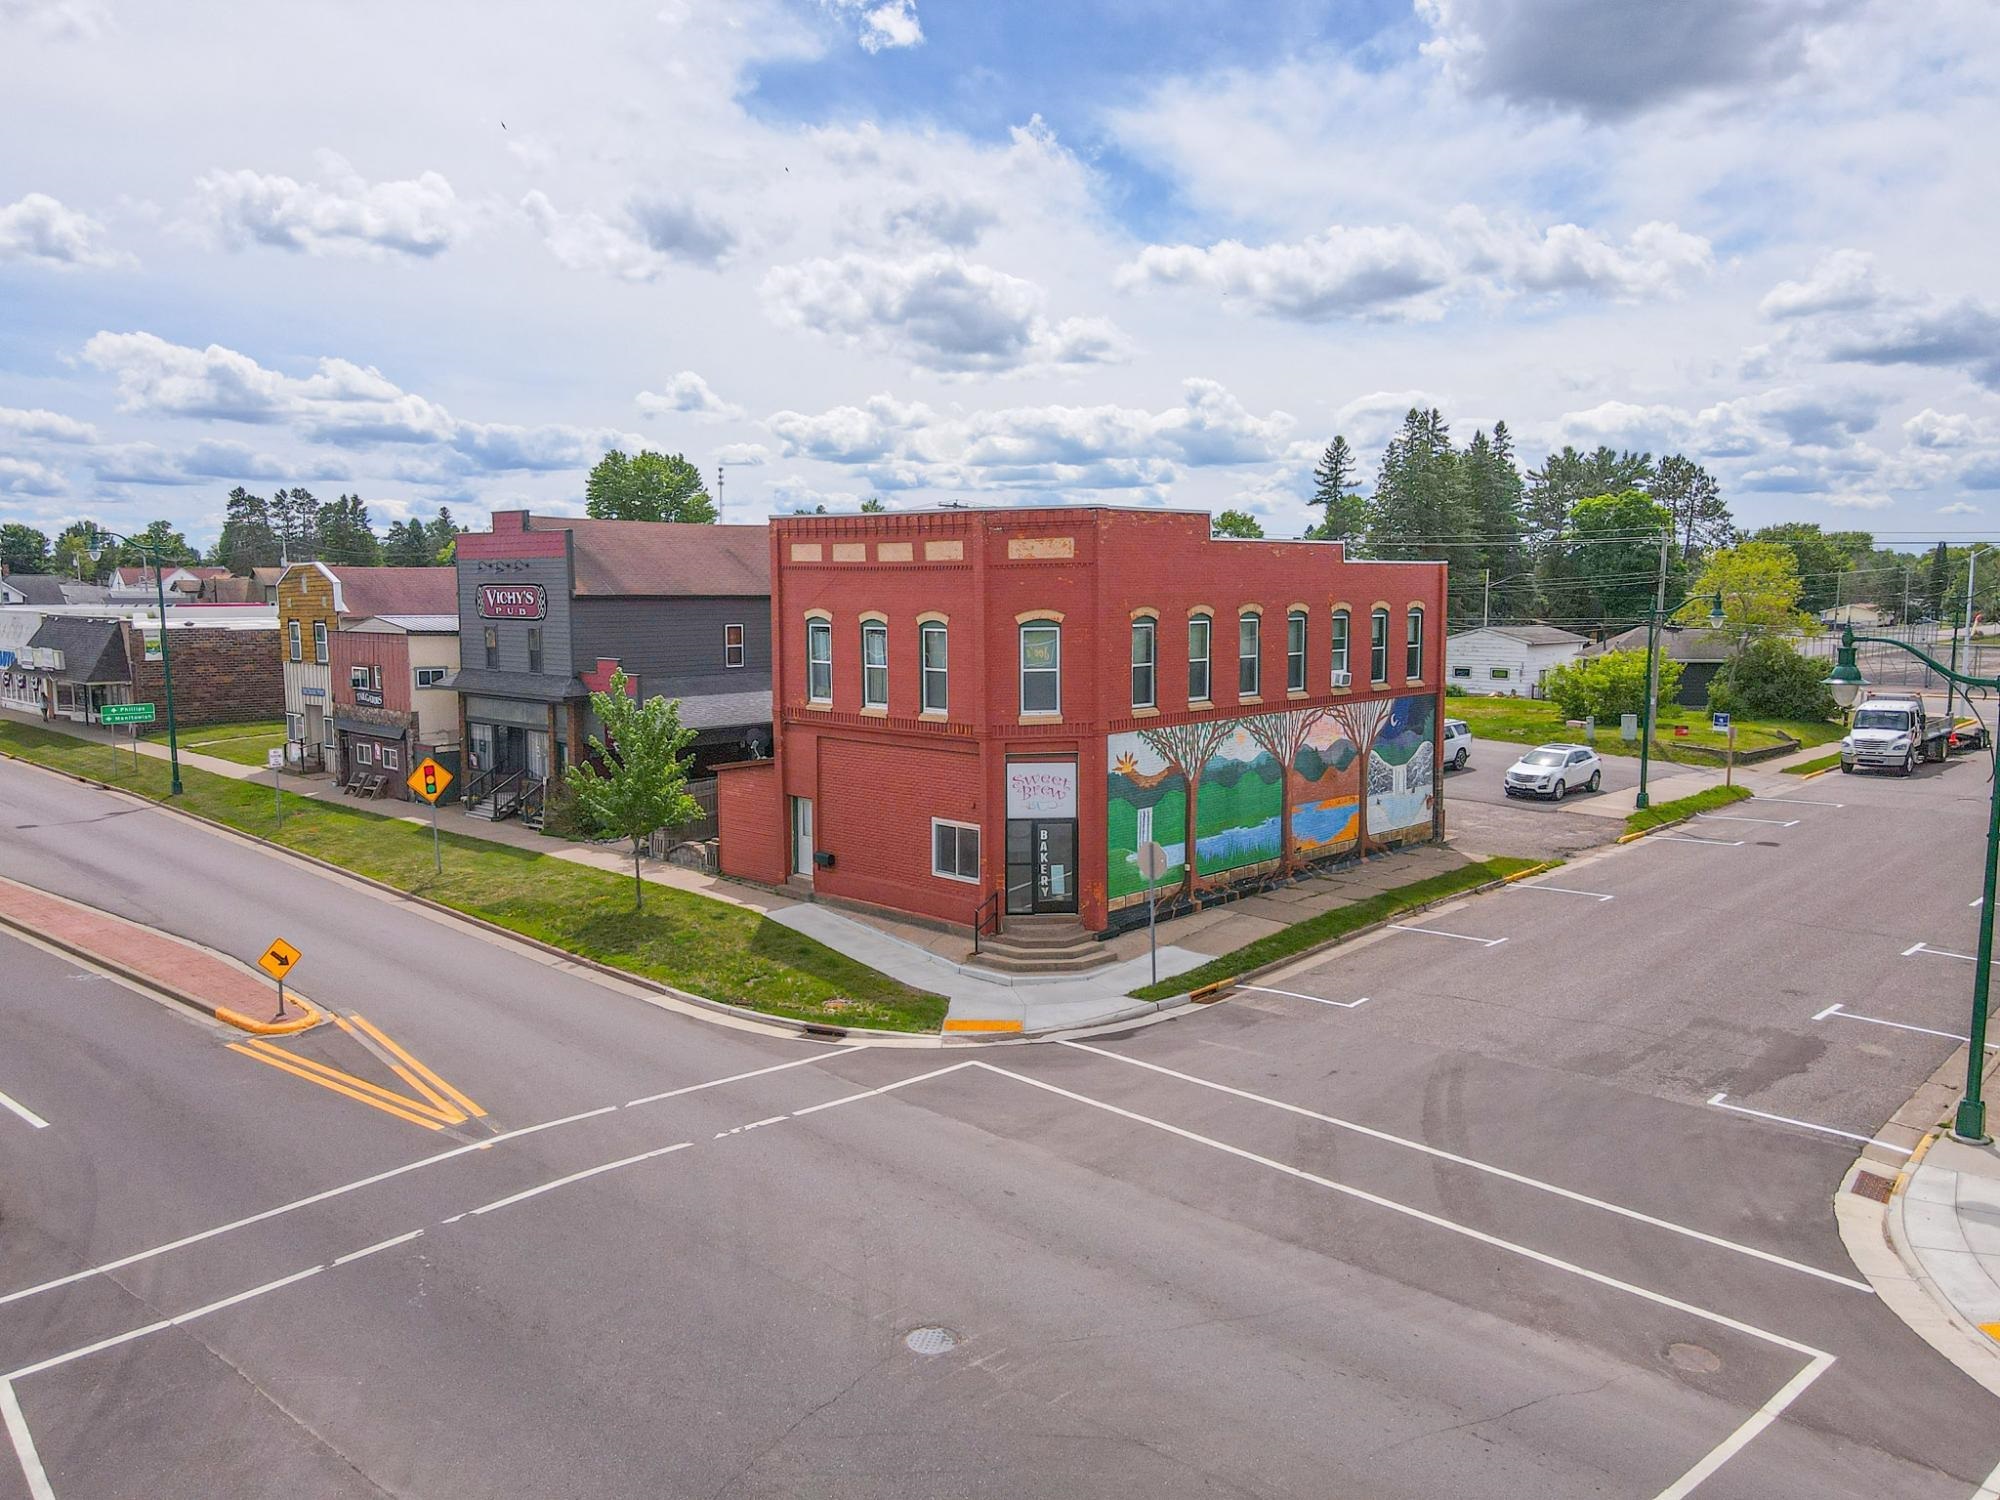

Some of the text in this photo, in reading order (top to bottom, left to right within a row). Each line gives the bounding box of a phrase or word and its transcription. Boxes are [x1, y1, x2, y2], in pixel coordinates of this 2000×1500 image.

[485, 589, 534, 608] VICHY'S
[495, 607, 526, 615] PUB
[1020, 785, 1067, 800] Brew
[1039, 829, 1049, 897] BAKERY
